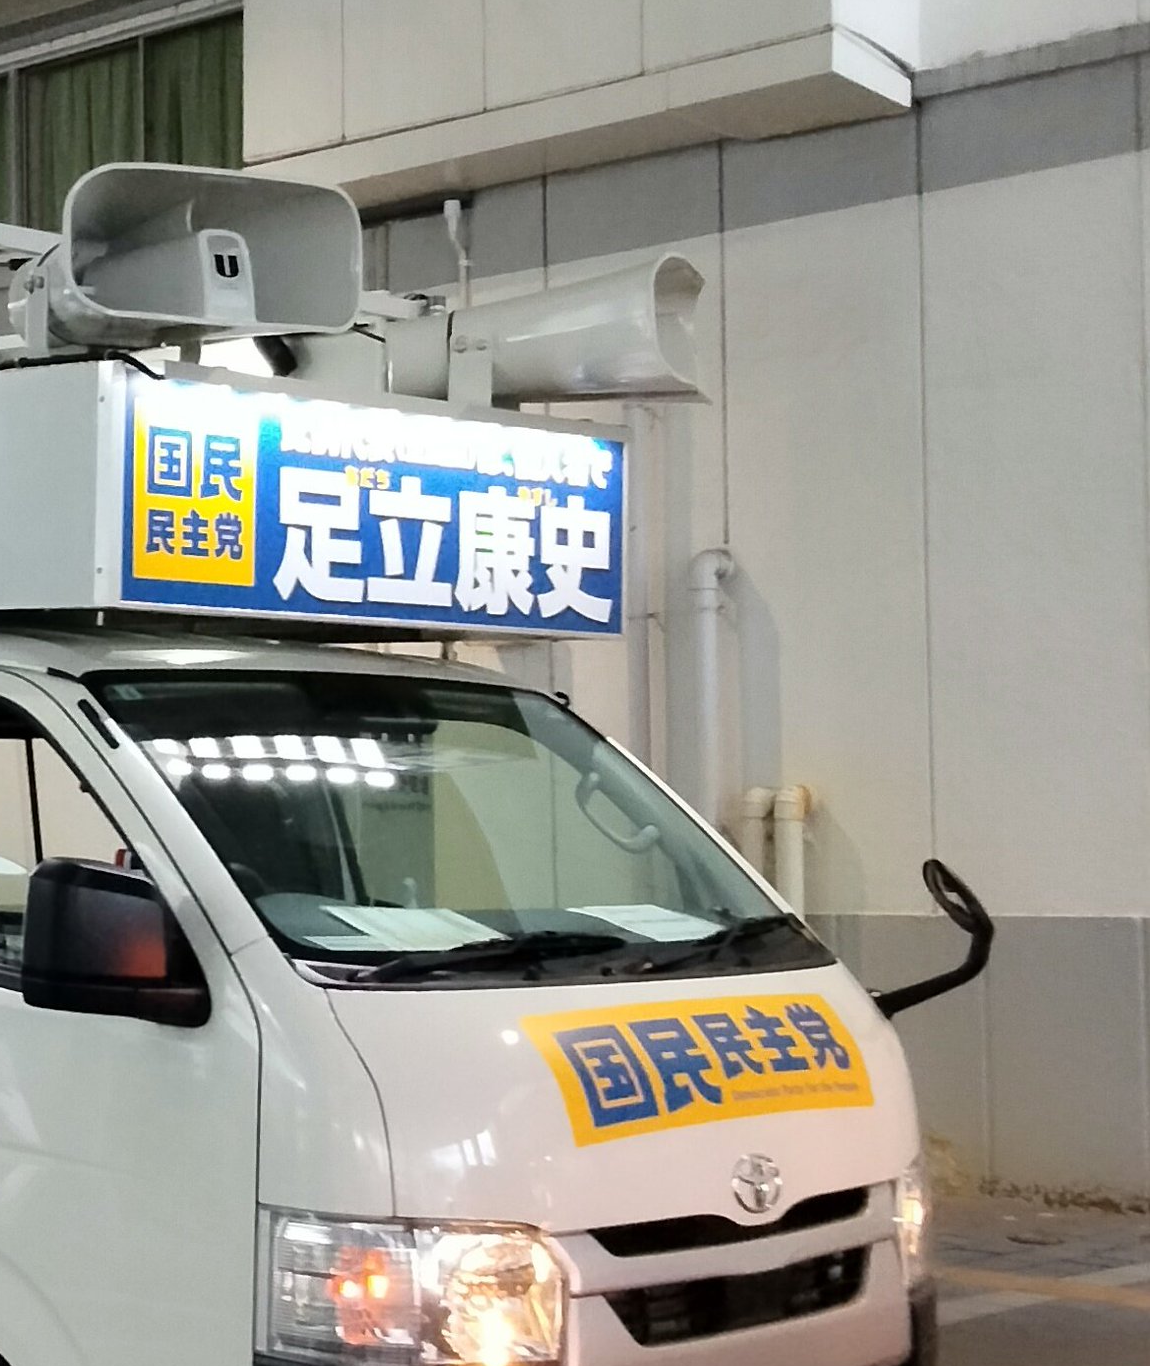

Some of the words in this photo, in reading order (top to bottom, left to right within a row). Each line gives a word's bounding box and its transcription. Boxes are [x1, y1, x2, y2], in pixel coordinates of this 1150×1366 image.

[213, 254, 239, 278] U
[147, 426, 243, 502] 国民
[145, 508, 244, 561] 民主党
[273, 466, 614, 624] 足立康史
[552, 1003, 850, 1128] 国民民主党
